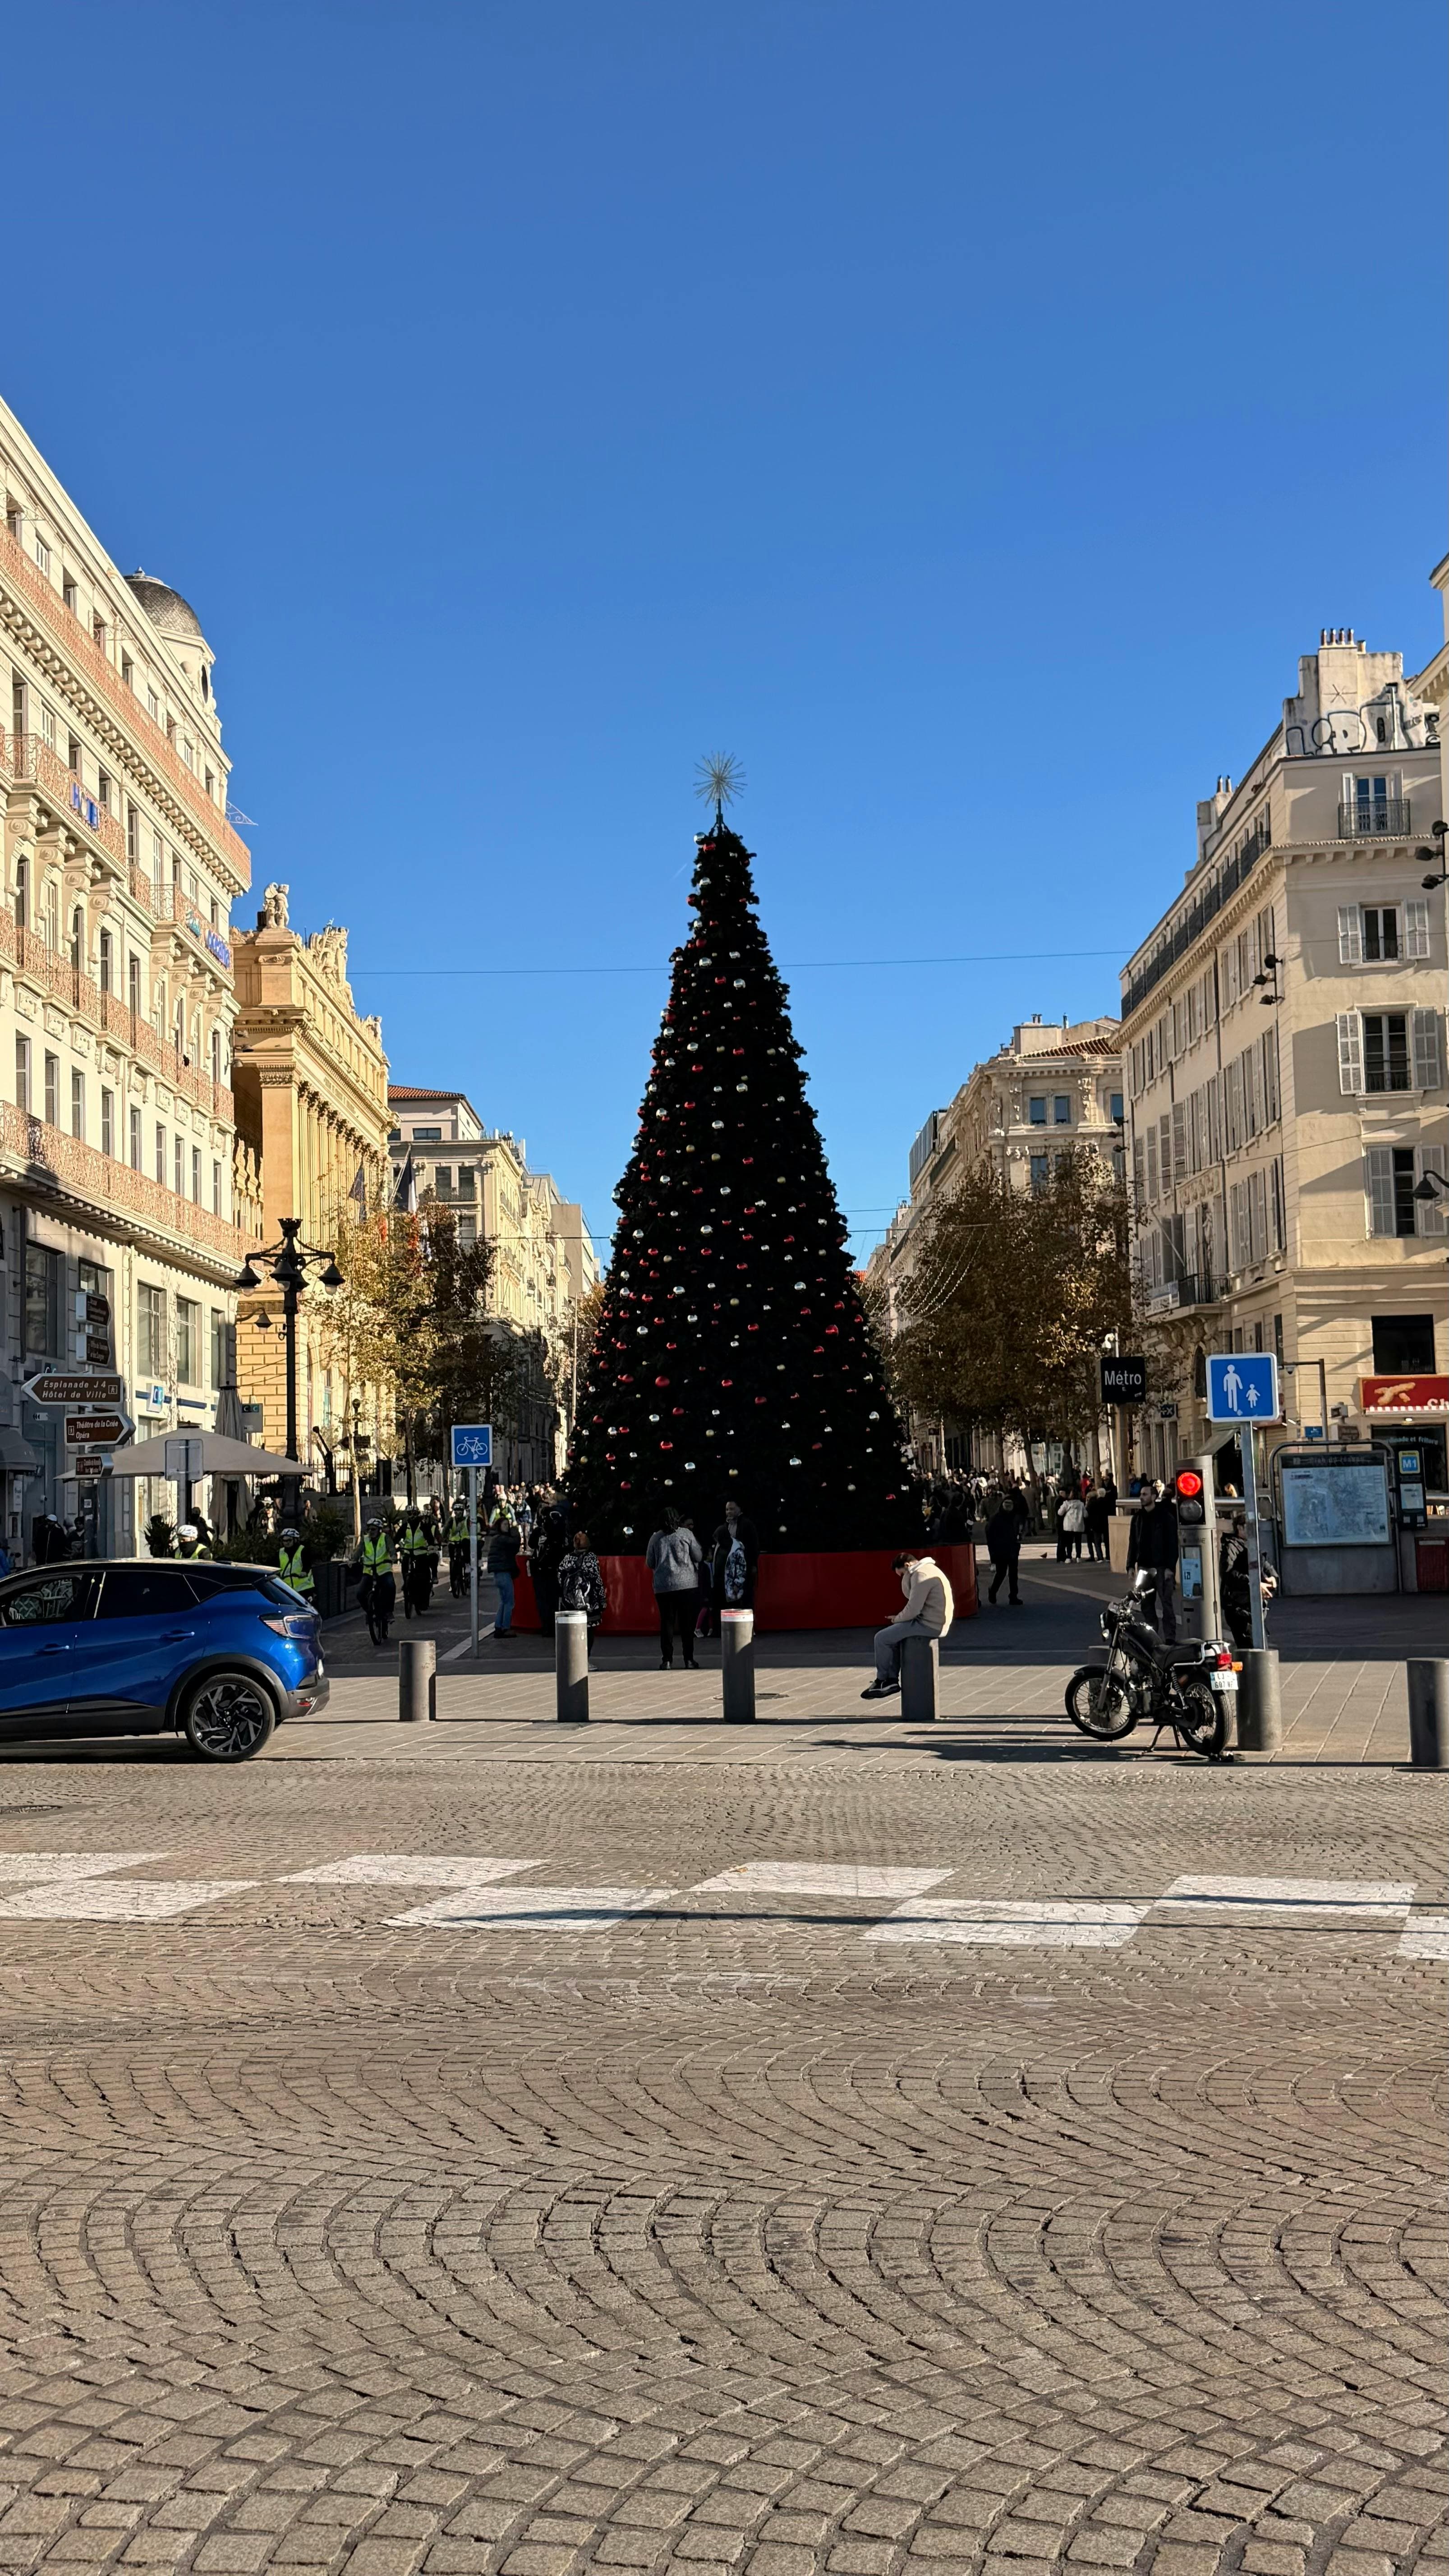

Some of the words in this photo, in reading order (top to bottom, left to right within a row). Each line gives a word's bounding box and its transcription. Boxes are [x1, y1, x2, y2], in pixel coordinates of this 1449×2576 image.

[1105, 1370, 1141, 1385] Métro
[44, 1380, 89, 1389] Esplanade
[42, 1390, 66, 1398] Hôtel
[77, 1421, 93, 1429] Théâtre
[76, 1431, 90, 1440] Opéra
[1403, 1459, 1417, 1468] M1
